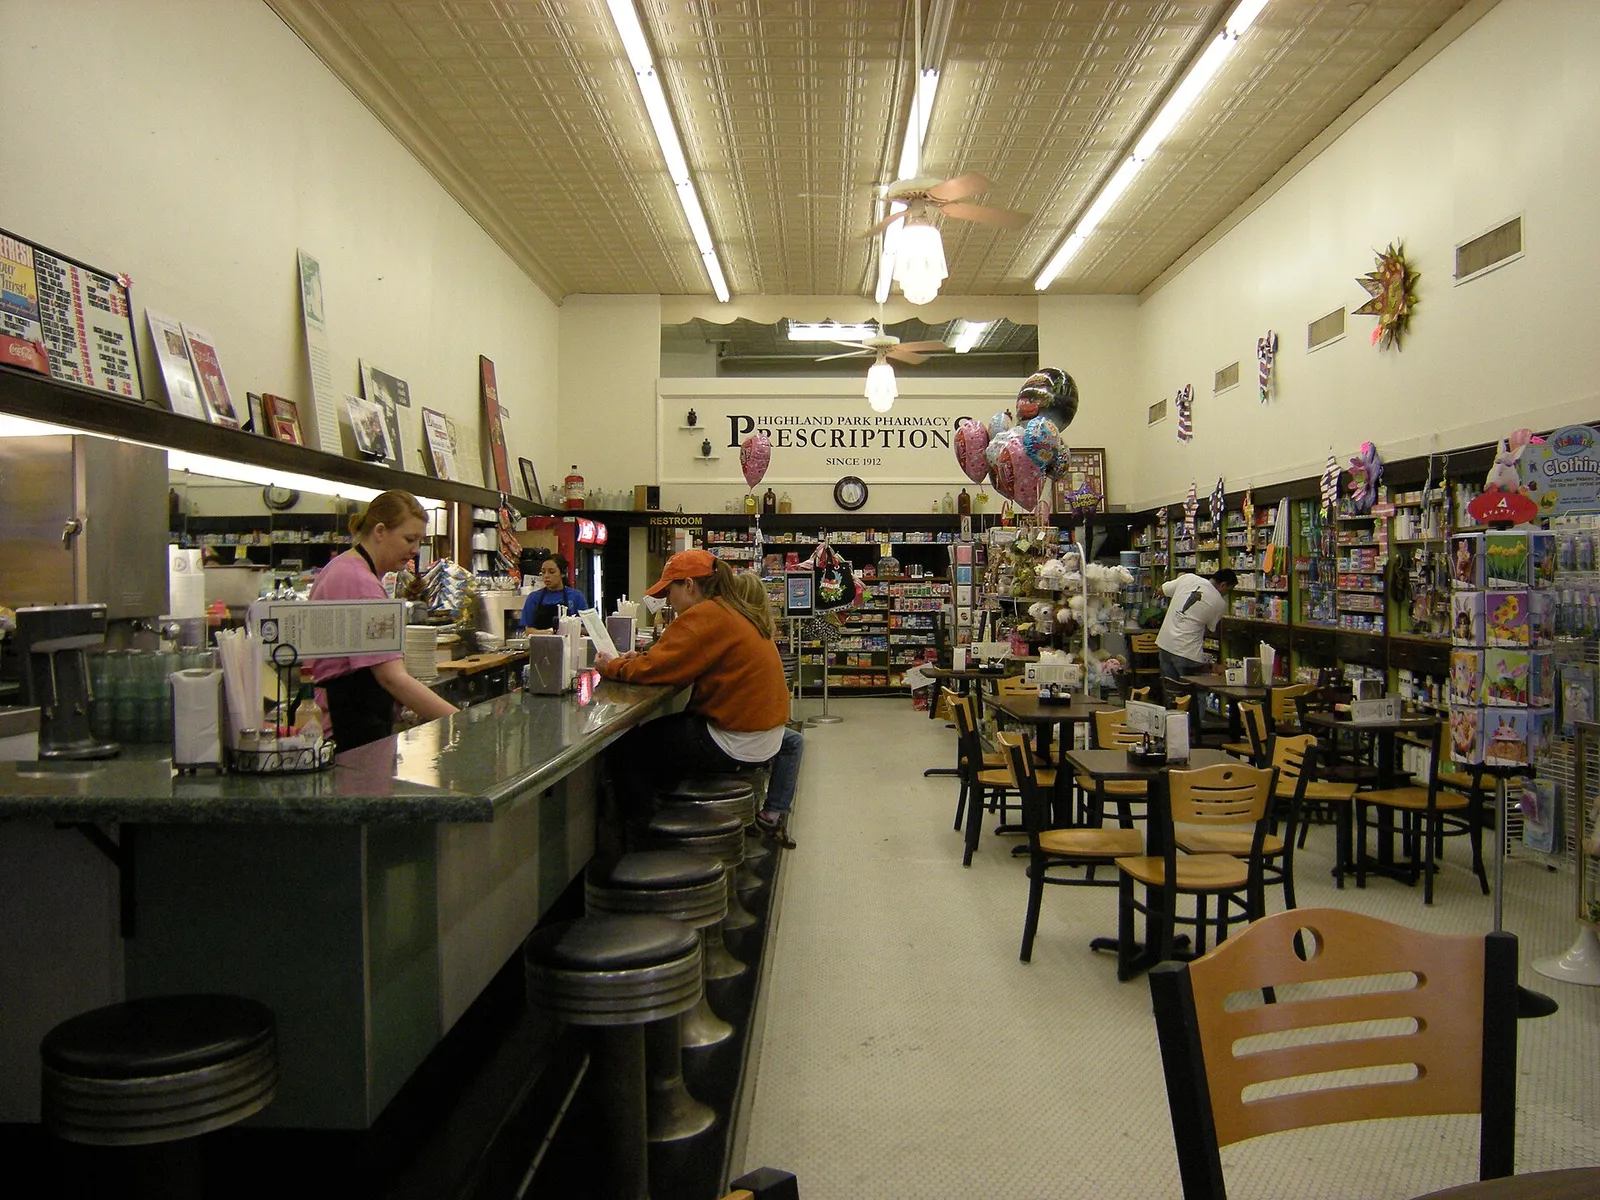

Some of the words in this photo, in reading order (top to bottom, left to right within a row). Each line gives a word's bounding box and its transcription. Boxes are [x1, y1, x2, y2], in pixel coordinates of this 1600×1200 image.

[9, 343, 33, 360] Coca-Cola
[757, 416, 833, 426] HIGHLAND
[837, 416, 871, 426] PARK
[875, 416, 951, 426] PHARMACY
[726, 415, 973, 448] PRESCRIPTION
[826, 457, 860, 466] SINCE
[863, 457, 882, 466] 1912
[650, 516, 703, 525] RESTROOM
